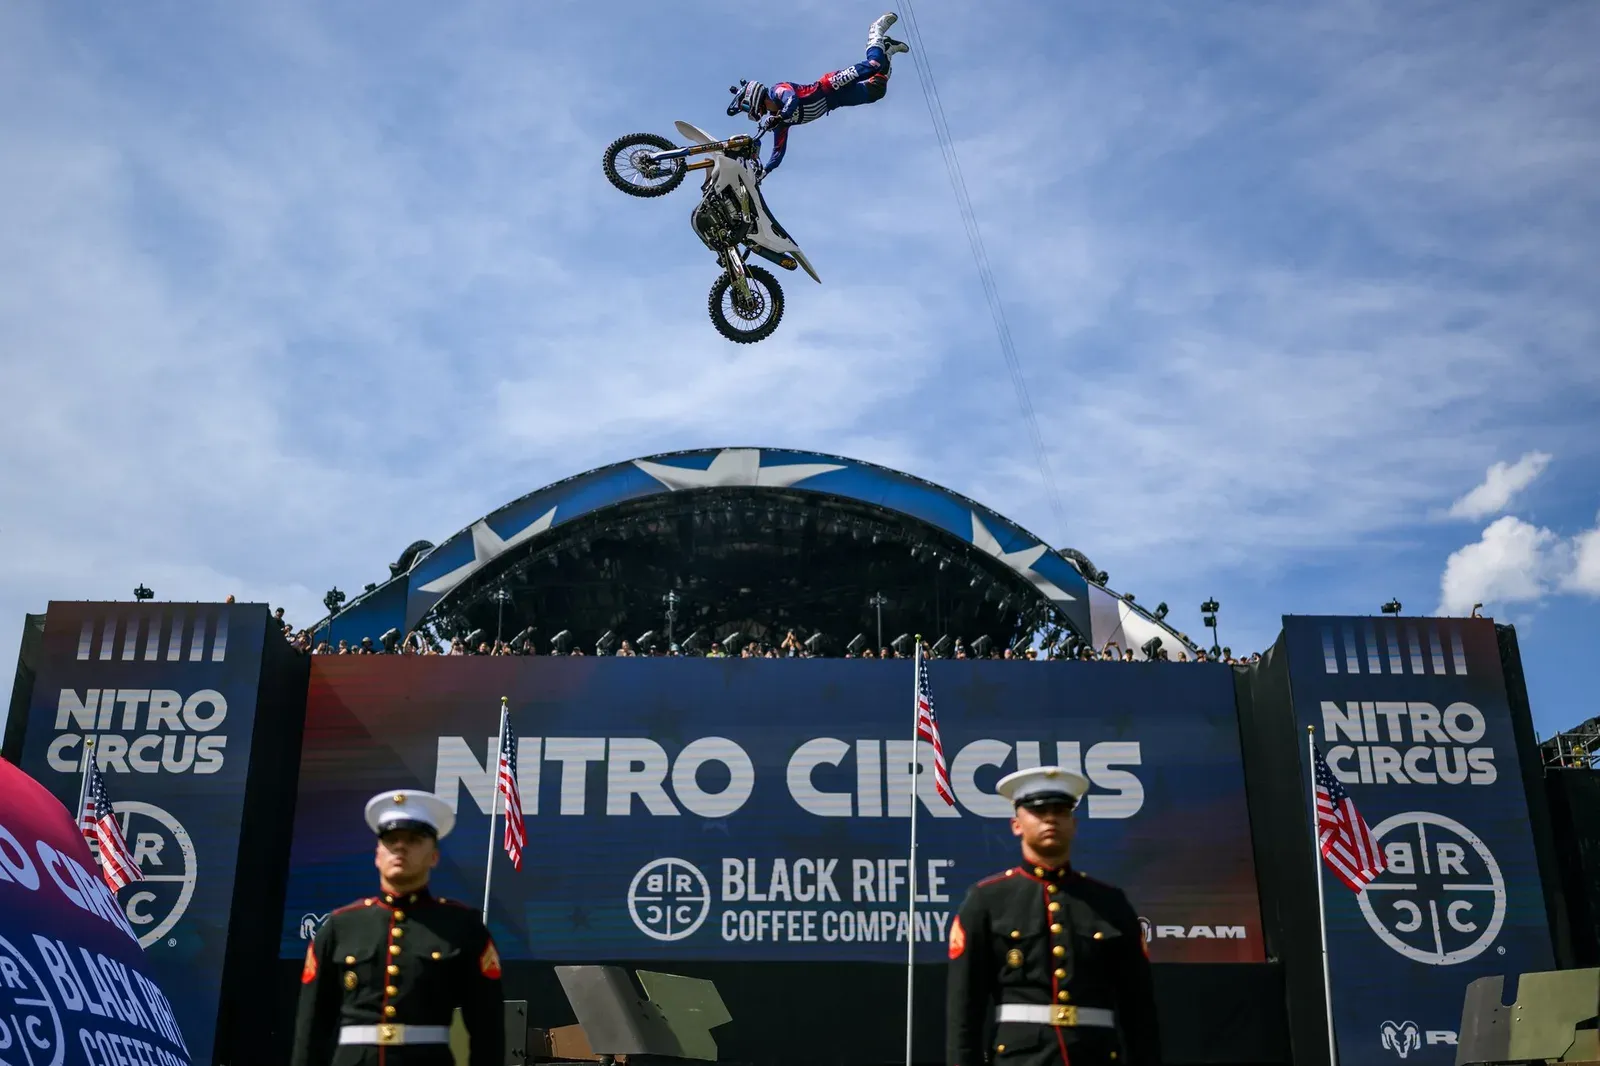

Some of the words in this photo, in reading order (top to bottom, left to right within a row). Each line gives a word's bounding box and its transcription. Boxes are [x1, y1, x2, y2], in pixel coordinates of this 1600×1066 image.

[831, 69, 860, 91] NITRO
[54, 688, 228, 732] NITRO
[1320, 701, 1486, 744] NITRO
[46, 733, 228, 774] CIRCUS
[1325, 745, 1498, 785] CIRCUS
[434, 736, 755, 818] NITRO
[721, 858, 842, 902] BLACK
[852, 858, 950, 903] RIFLE
[721, 910, 818, 942] COFFEE
[822, 911, 950, 942] COMPANY
[1156, 925, 1247, 939] RAM
[32, 933, 156, 1033] BLACK
